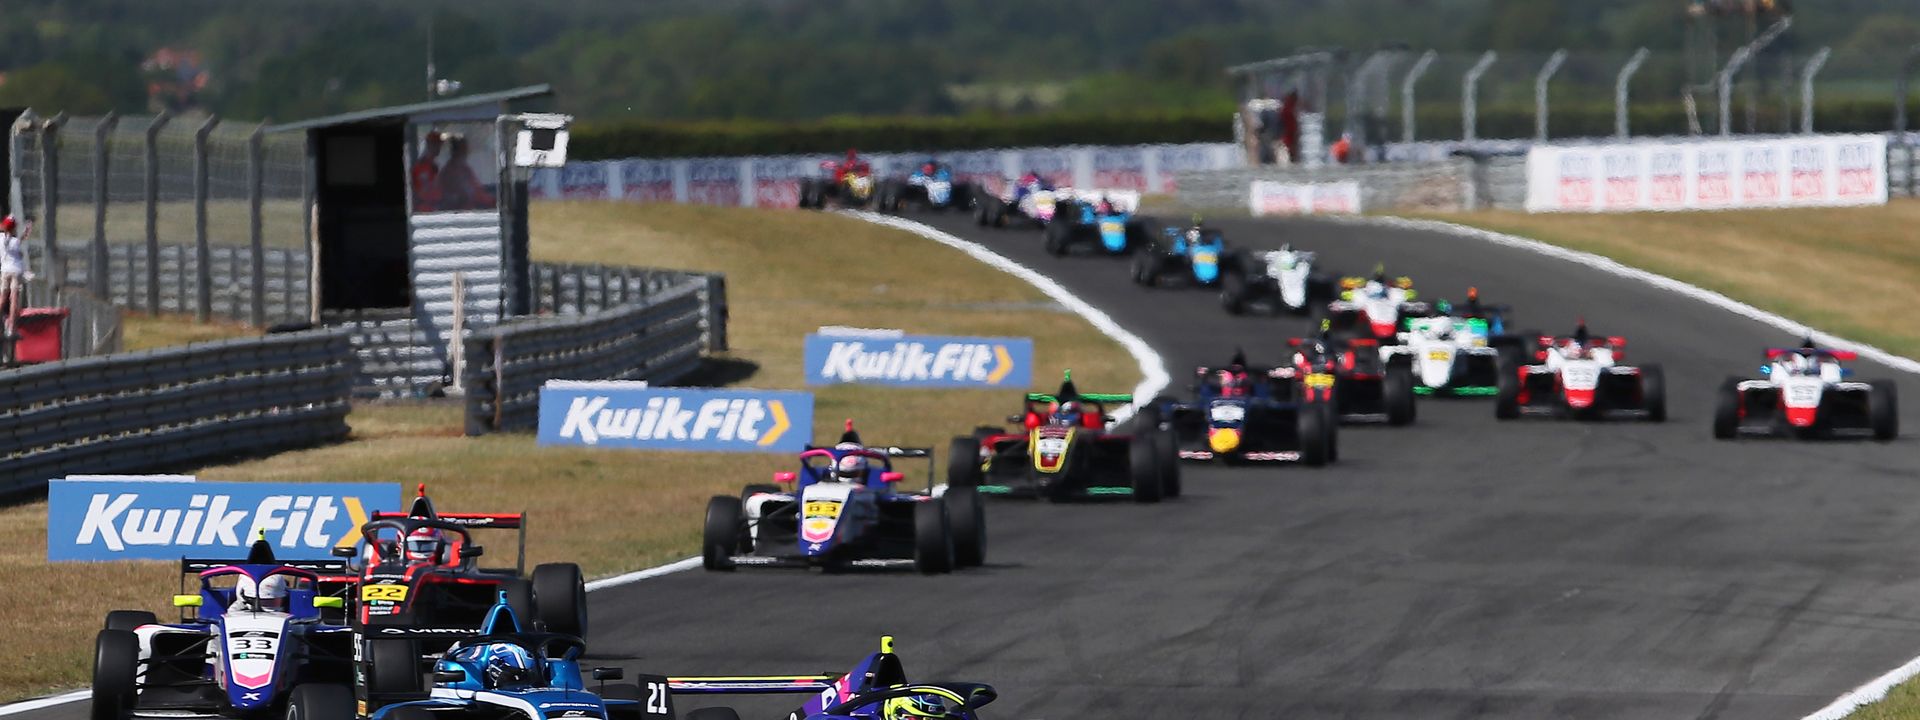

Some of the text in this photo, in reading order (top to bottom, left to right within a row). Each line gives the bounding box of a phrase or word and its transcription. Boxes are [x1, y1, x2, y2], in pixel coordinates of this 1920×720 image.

[367, 587, 402, 598] 22
[234, 639, 272, 650] 33
[647, 682, 667, 714] 21
